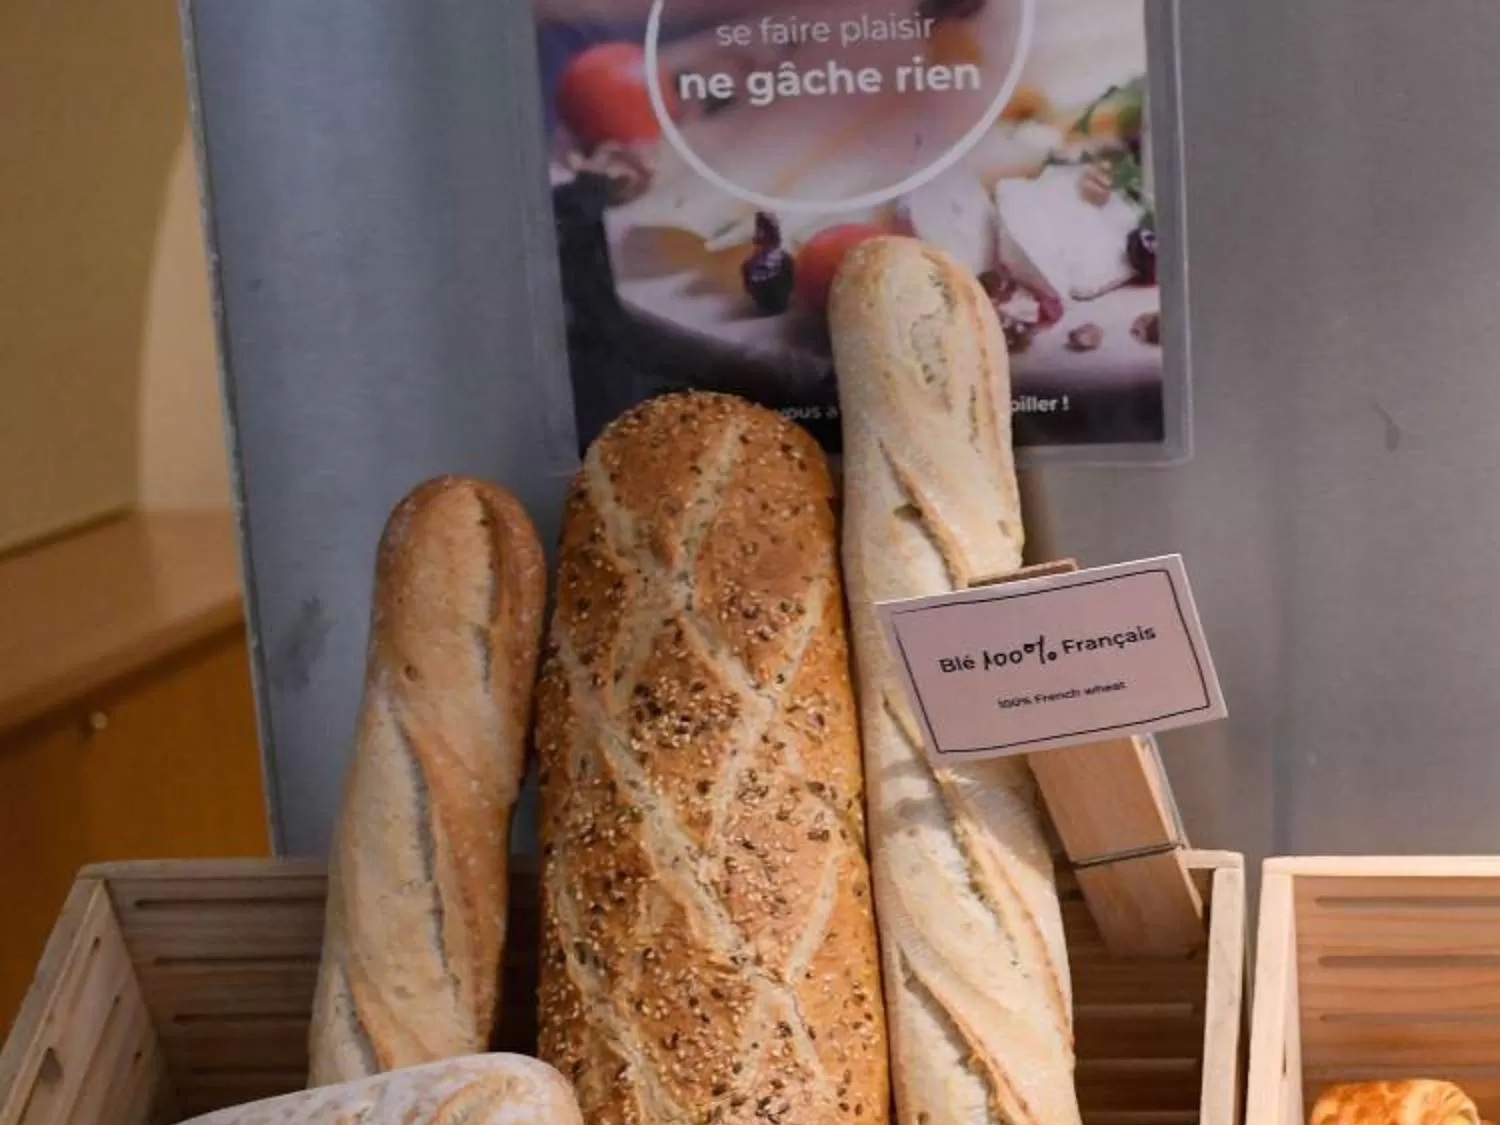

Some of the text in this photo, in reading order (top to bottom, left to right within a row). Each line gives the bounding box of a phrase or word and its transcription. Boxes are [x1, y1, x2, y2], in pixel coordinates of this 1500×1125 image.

[715, 12, 935, 48] se faire plaisir
[679, 55, 982, 106] ne gâche rien
[939, 625, 1157, 673] Blé 100% Français
[1034, 688, 1081, 704] French
